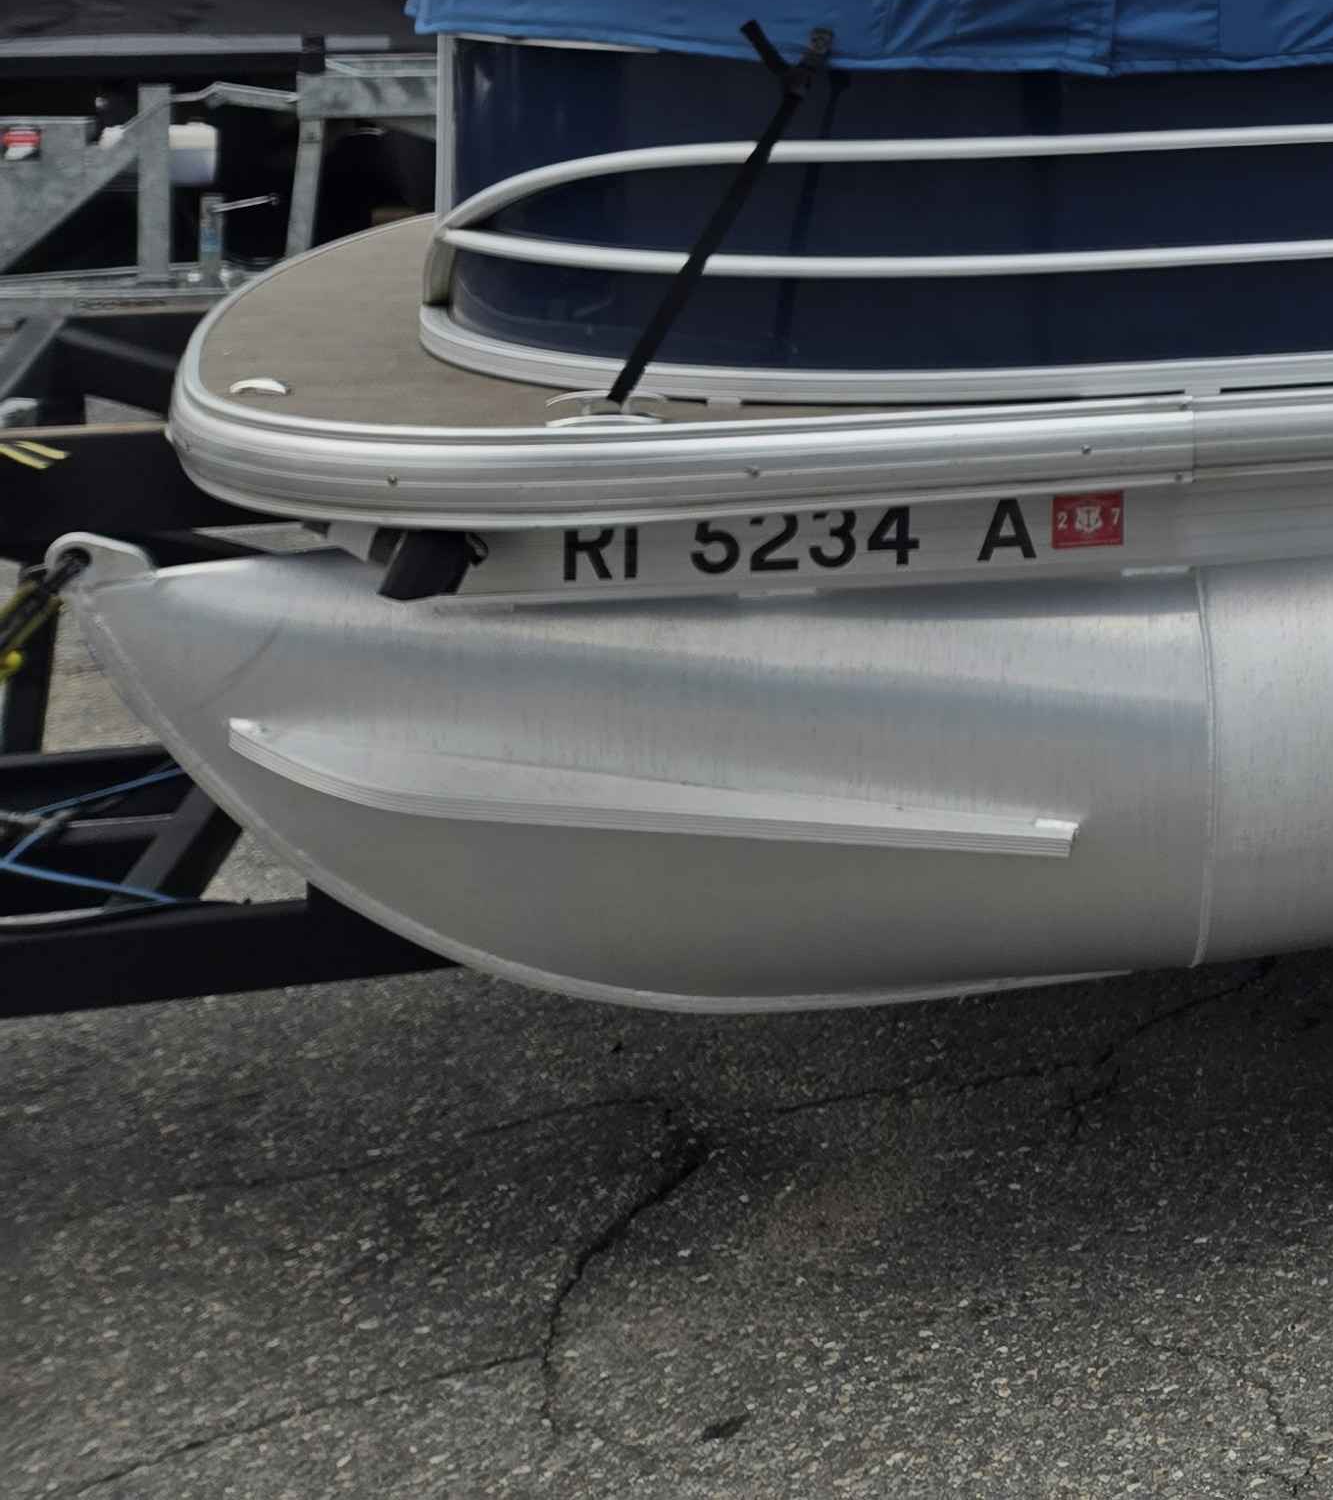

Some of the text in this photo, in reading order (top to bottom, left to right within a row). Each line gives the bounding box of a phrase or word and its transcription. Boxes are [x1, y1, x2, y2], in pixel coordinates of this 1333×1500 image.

[563, 497, 1037, 581] RI 5234 A
